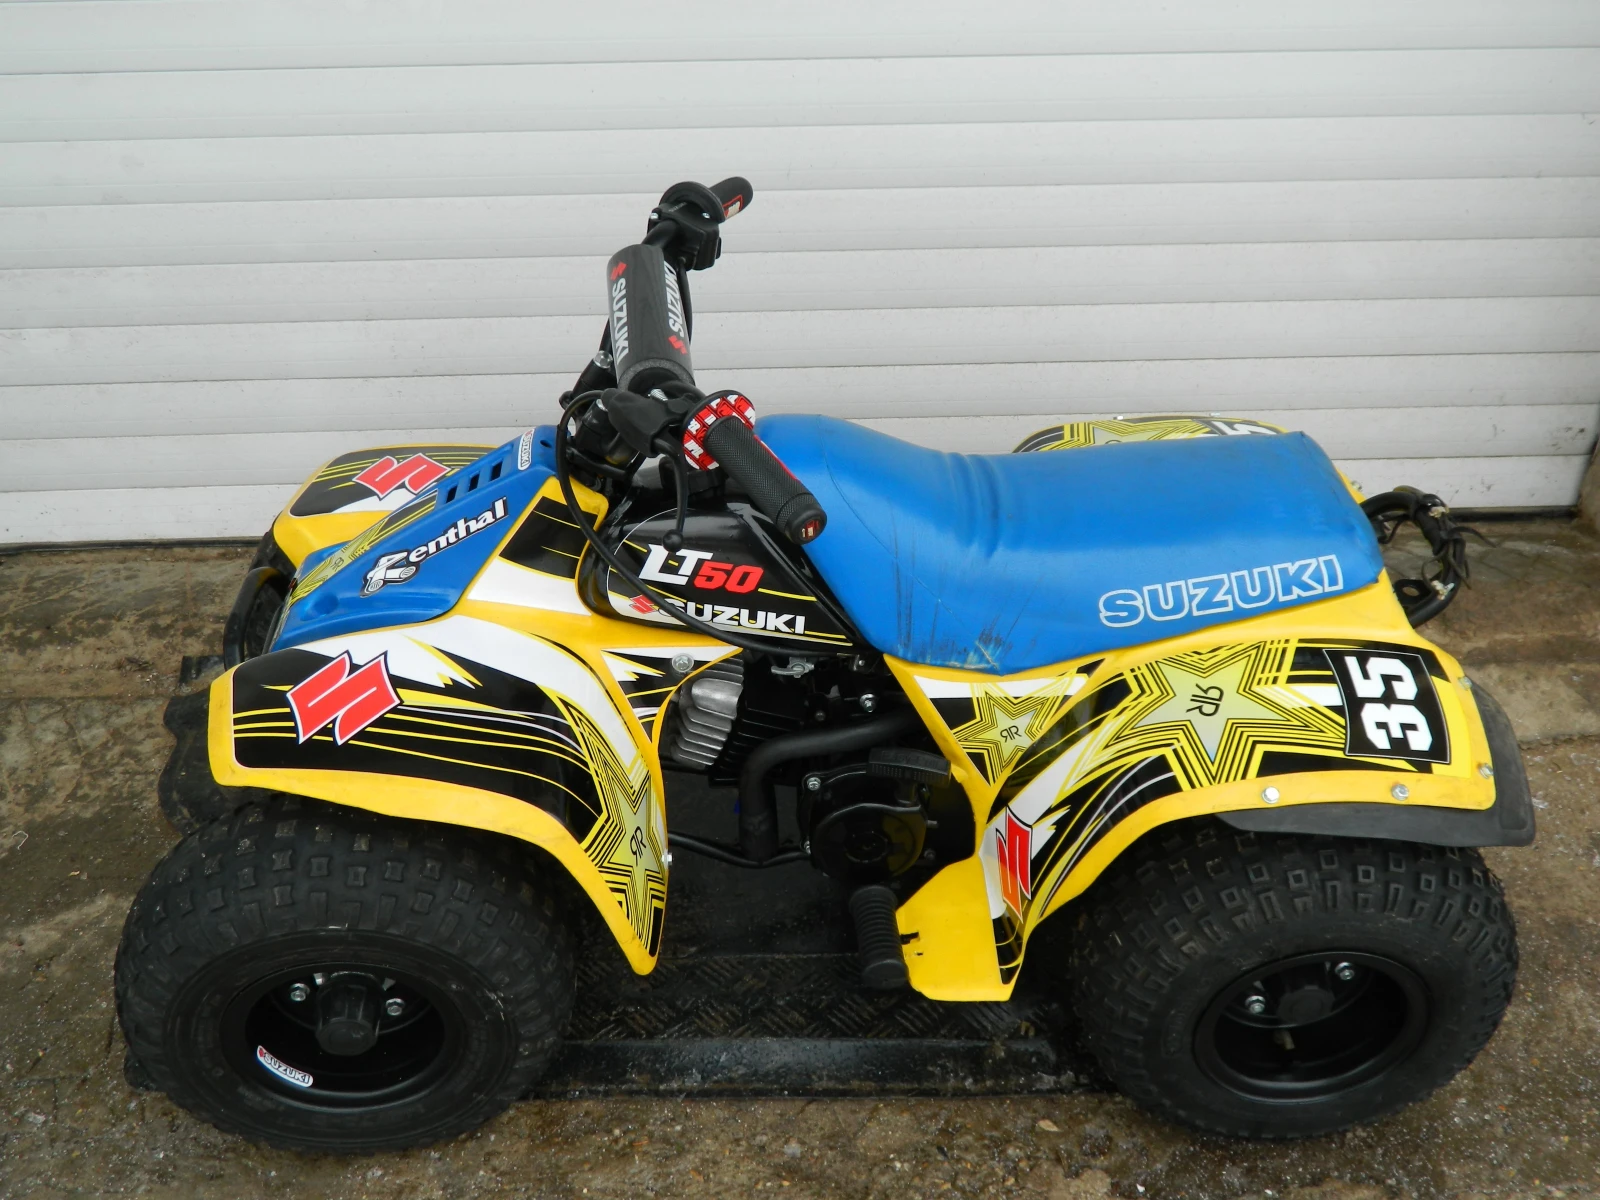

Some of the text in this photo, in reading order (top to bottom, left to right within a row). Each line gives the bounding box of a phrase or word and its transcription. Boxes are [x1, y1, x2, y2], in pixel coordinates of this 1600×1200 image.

[611, 277, 629, 366] SUZUKI
[663, 260, 685, 338] SUZUKI
[365, 497, 506, 594] Renthal
[1098, 554, 1344, 628] SUZUKI
[1344, 655, 1433, 752] 35
[263, 1051, 311, 1085] SUZUKI
